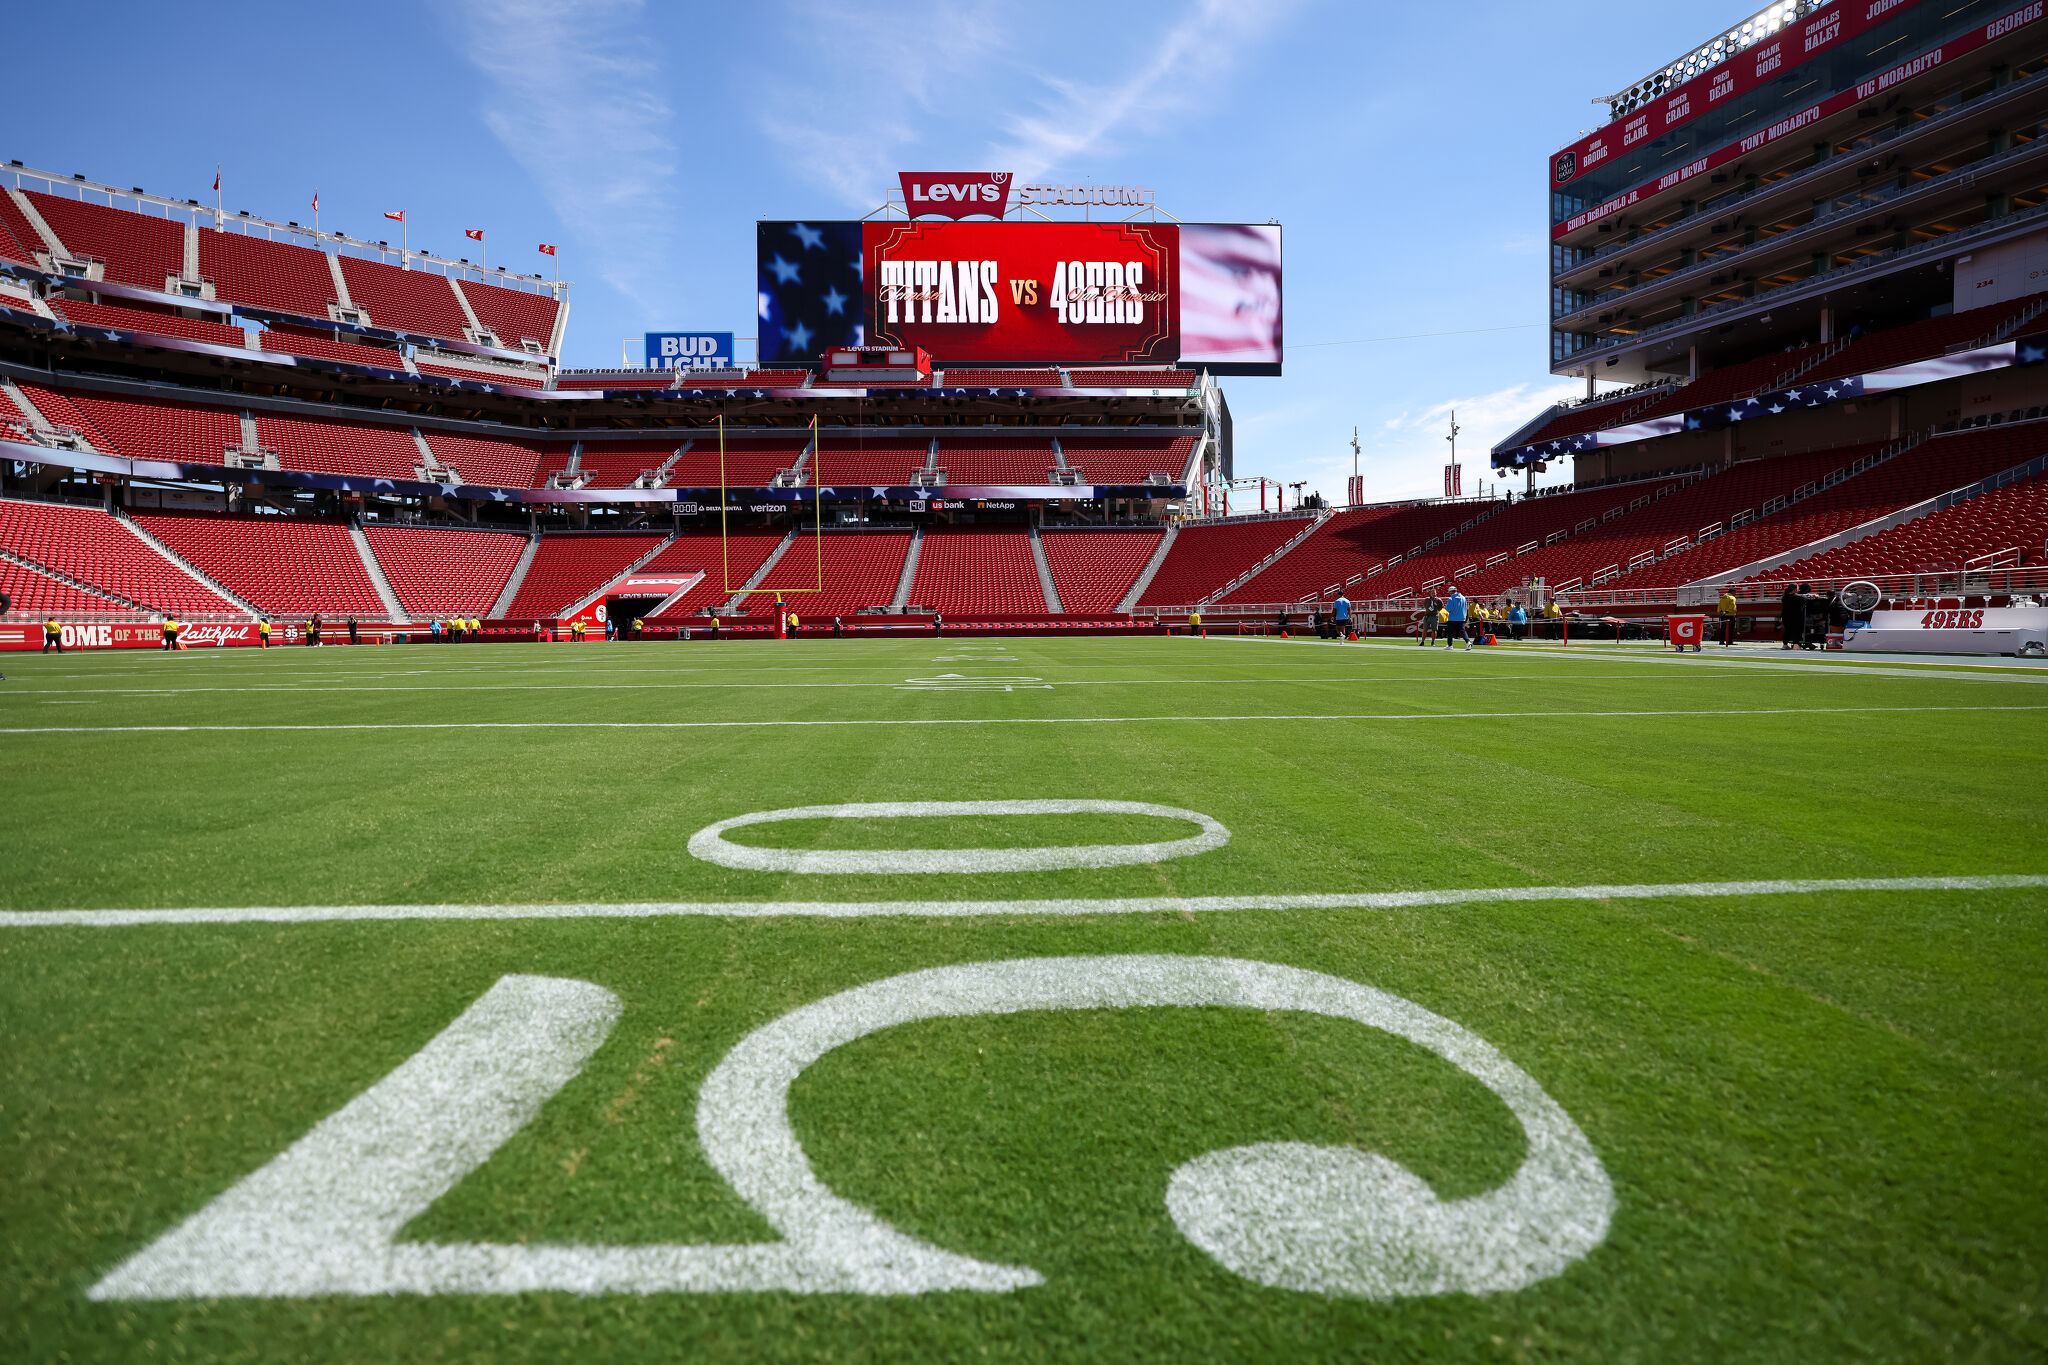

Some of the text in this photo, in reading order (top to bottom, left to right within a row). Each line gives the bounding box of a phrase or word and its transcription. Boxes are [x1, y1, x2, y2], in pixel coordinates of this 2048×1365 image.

[1806, 10, 1840, 36] CHARLES
[1987, 1, 2043, 40] GEORGE
[1804, 22, 1841, 52] HALEY
[1757, 42, 1780, 62] FRANK
[1756, 54, 1782, 78] GORE
[1856, 48, 1942, 99] VIC MORABITO
[1713, 70, 1730, 86] FRED
[1709, 78, 1734, 102] DEAN
[1668, 93, 1687, 110] ROGER
[1625, 115, 1647, 132] DWIGHT
[1666, 102, 1690, 124] CRAIG
[1623, 124, 1649, 146] CLARK
[1740, 105, 1820, 153] TONY MORABITO
[1589, 138, 1602, 152] JOHN
[1583, 146, 1608, 168] BRODIE
[1658, 173, 1679, 190] JOHN
[1020, 183, 1145, 206] STADIUM
[1567, 214, 1586, 232] EDDIE
[1628, 191, 1640, 207] JR.
[881, 260, 999, 324] TITANS
[1009, 279, 1038, 306] VS
[1050, 260, 1144, 324] 49ERS
[661, 337, 718, 356] BUD
[750, 503, 787, 512] verizon
[944, 501, 965, 509] bank
[986, 502, 1015, 511] NetApp
[1350, 614, 1376, 632] OME
[1676, 621, 1694, 638] G
[1920, 609, 1985, 630] 49ERS
[44, 622, 249, 646] OME OF THE Faithful
[285, 628, 298, 638] 35
